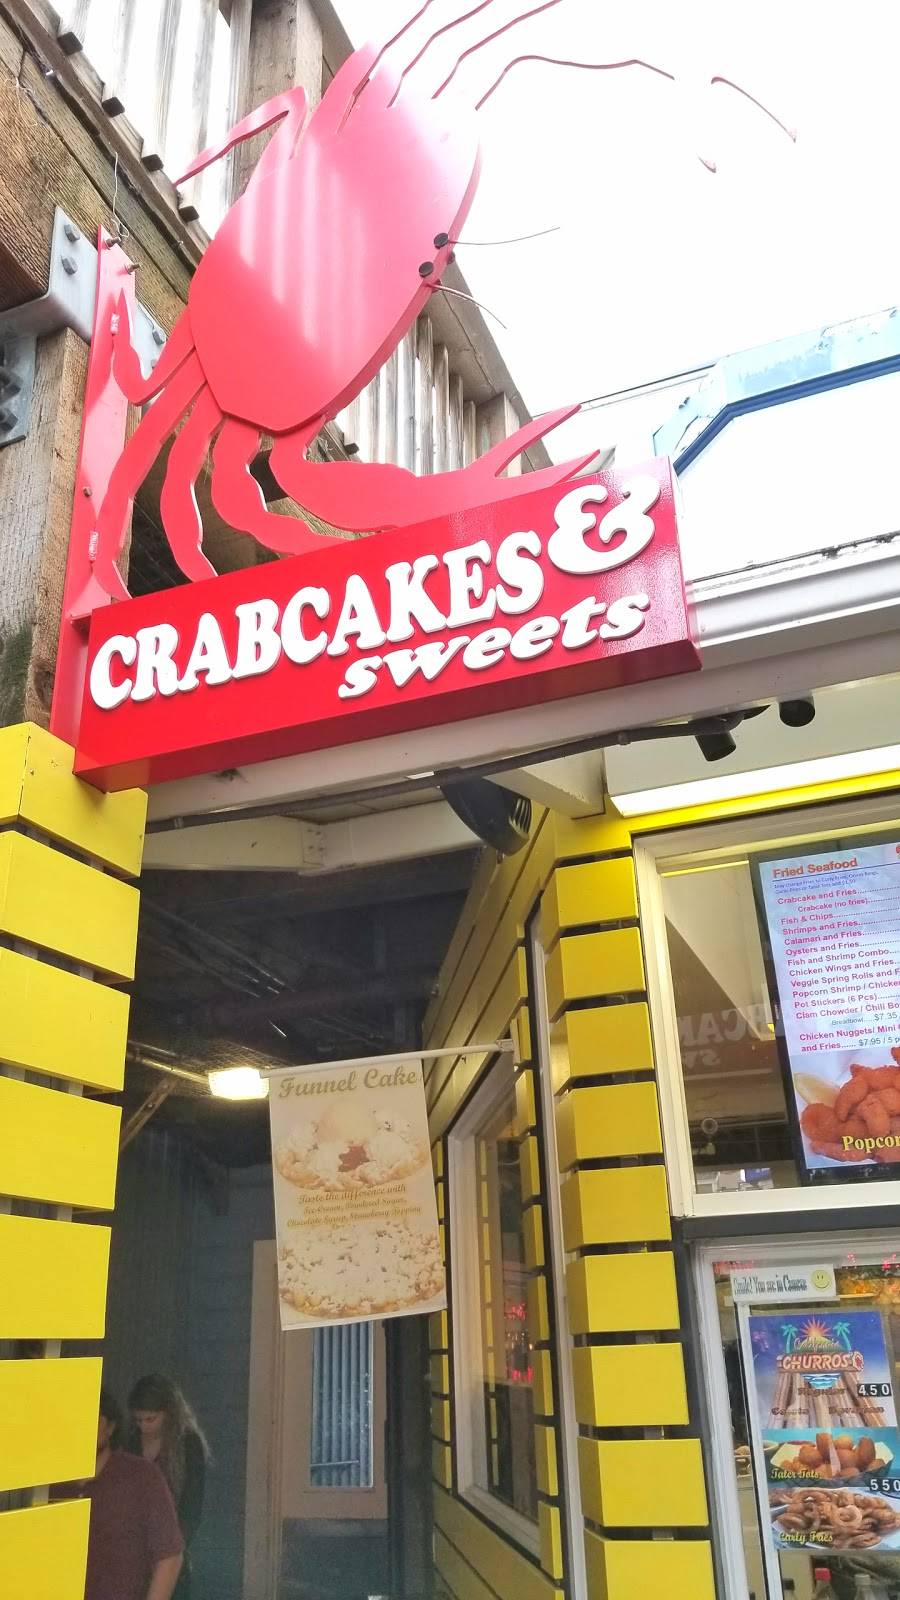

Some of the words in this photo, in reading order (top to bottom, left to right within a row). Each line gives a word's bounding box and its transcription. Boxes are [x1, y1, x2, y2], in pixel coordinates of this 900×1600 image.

[89, 530, 545, 710] CRABCAKES
[547, 474, 661, 575] &
[337, 592, 651, 700] sweets
[772, 866, 803, 879] Fried
[807, 858, 858, 874] Seafood
[777, 895, 816, 905] Crabcake
[819, 892, 834, 900] and
[836, 888, 858, 897] Fries
[797, 902, 833, 912] Crabcake
[834, 900, 847, 909] (no
[780, 917, 799, 926] Fish
[809, 913, 834, 922] Chips
[783, 926, 817, 936] Shrimps
[784, 936, 821, 946] Calamari
[823, 933, 839, 941] and
[785, 946, 818, 957] Oysters
[820, 944, 836, 952] and
[839, 941, 860, 949] Fries
[787, 958, 806, 967] Fish
[807, 955, 823, 964] and
[825, 951, 856, 962] Shrimp
[858, 948, 890, 958] Combo
[789, 968, 823, 977] Chicken
[824, 964, 852, 973] Wings
[854, 961, 871, 969] and
[790, 978, 819, 988] Veggie
[821, 974, 850, 984] Spring
[851, 971, 874, 980] Rolls
[876, 967, 893, 977] and
[792, 988, 829, 999] Popcorn
[830, 983, 862, 994] Shrimp
[794, 1000, 809, 1009] Pot
[810, 996, 846, 1007] Stickers
[847, 994, 856, 1003] (6
[796, 1010, 818, 1020] Clam
[819, 1006, 859, 1017] Chowder
[865, 1003, 886, 1012] Chili
[800, 1030, 835, 1041] Chicken
[877, 1024, 896, 1033] Mini
[801, 1044, 817, 1052] and
[820, 1041, 841, 1050] Fries
[858, 1037, 881, 1047] $7.95
[278, 1070, 358, 1099] Funnel
[363, 1065, 418, 1090] Cake
[298, 1193, 323, 1205] Taste
[325, 1191, 339, 1202] the
[340, 1186, 385, 1201] difference
[387, 1183, 406, 1195] with
[753, 1275, 766, 1294] You
[782, 1353, 851, 1370] CHURROS
[771, 1468, 797, 1479] Tater
